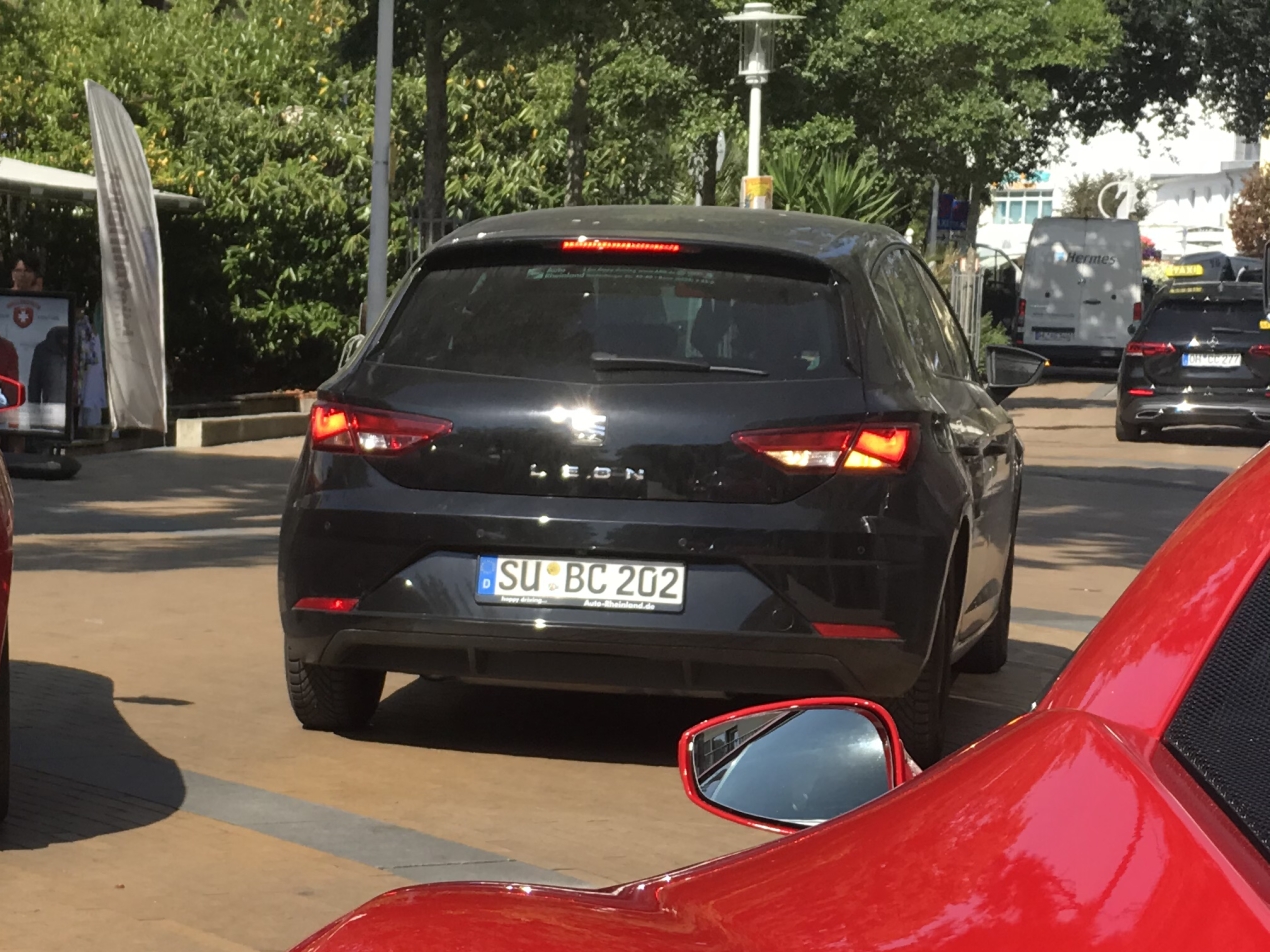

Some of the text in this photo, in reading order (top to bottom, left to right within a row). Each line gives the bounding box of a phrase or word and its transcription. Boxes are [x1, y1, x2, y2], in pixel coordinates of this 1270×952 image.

[1067, 251, 1116, 265] Hermes
[1173, 265, 1198, 276] TAXI
[1222, 354, 1240, 365] 277
[529, 463, 645, 480] LEON
[482, 578, 491, 589] D
[498, 560, 679, 600] SU BC 202
[583, 599, 656, 611] Auto-Rheinland.de
